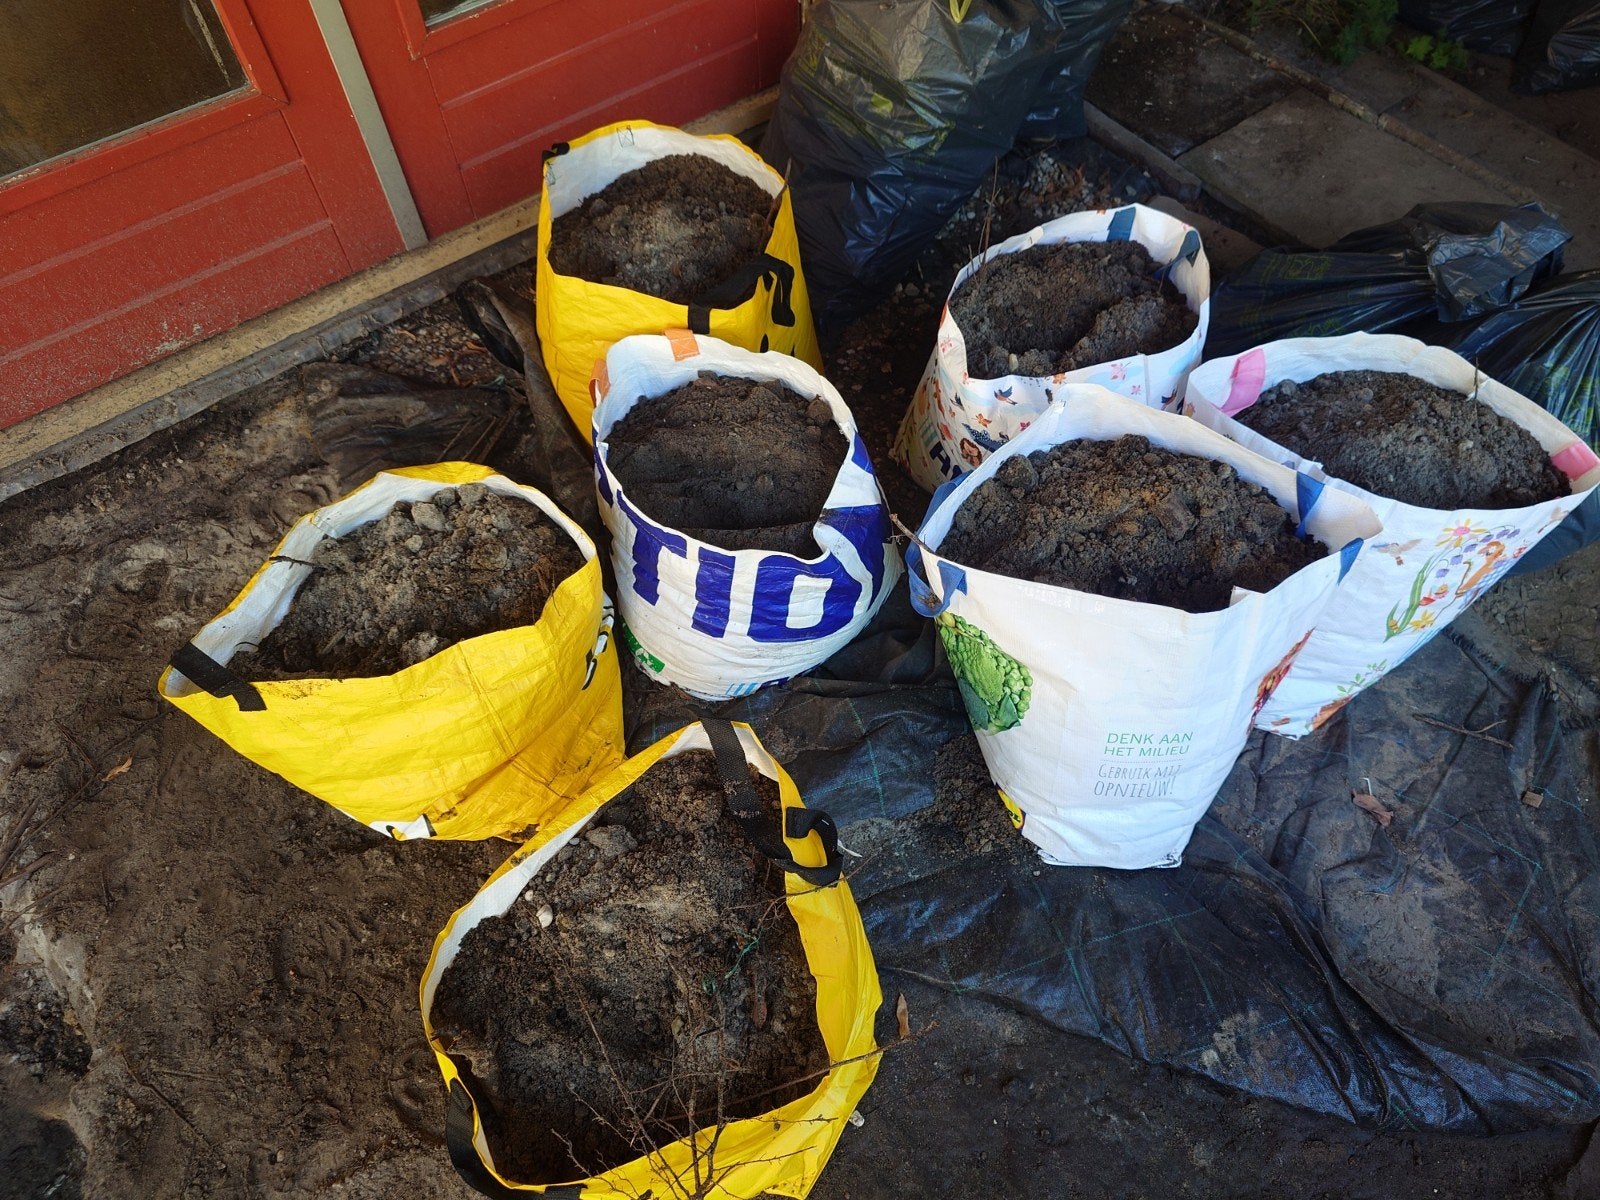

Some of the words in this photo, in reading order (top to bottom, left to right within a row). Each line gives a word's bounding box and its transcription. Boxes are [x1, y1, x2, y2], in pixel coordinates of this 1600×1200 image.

[1107, 732, 1154, 745] DENK
[1158, 731, 1194, 745] AAN
[1104, 746, 1135, 757] HET
[1138, 744, 1190, 757] MILIEU
[1098, 763, 1152, 780] GEBRUIK
[1093, 775, 1177, 798] OPNIEUW!
